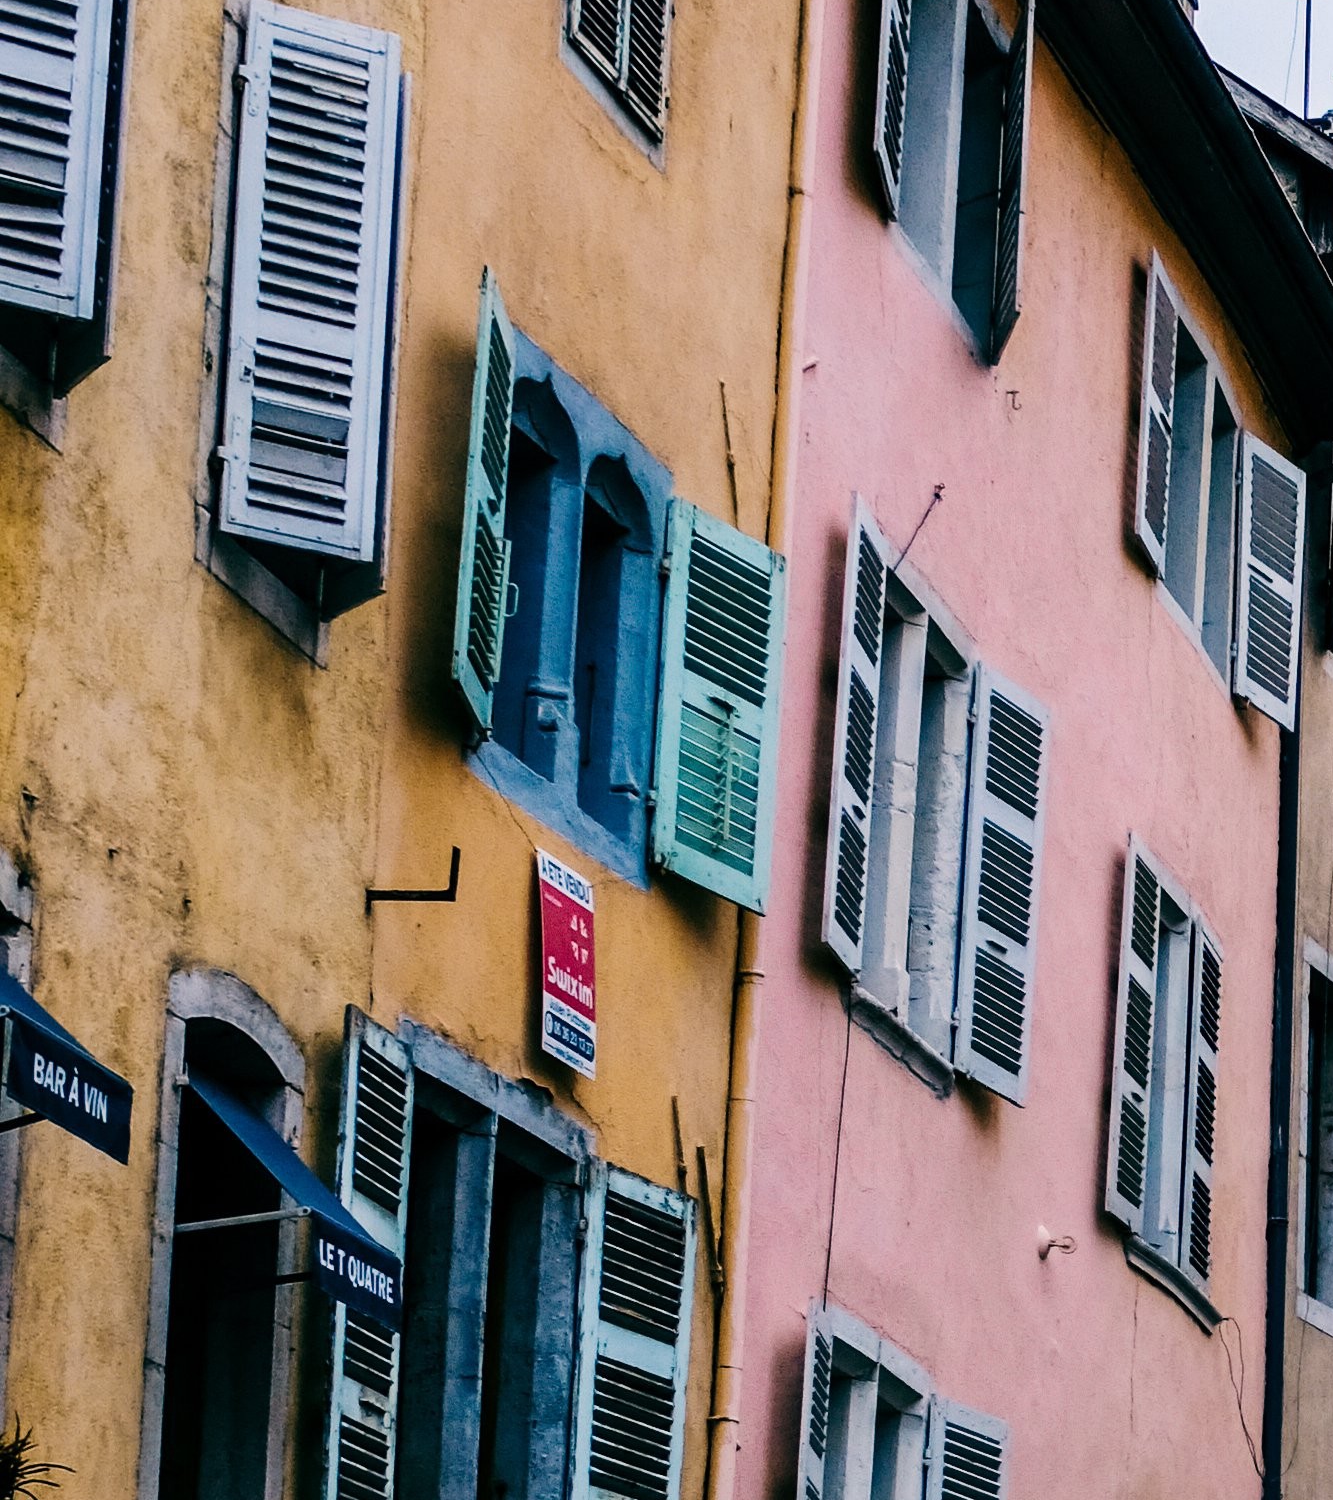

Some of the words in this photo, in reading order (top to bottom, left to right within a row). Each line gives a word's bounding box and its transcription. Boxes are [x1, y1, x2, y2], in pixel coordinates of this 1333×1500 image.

[547, 956, 593, 1009] Swixim
[33, 1052, 66, 1099] BAR
[68, 1067, 79, 1107] À
[83, 1086, 108, 1124] VIN
[318, 1239, 335, 1271] LE
[337, 1246, 346, 1276] T
[347, 1255, 394, 1304] QUATRE
